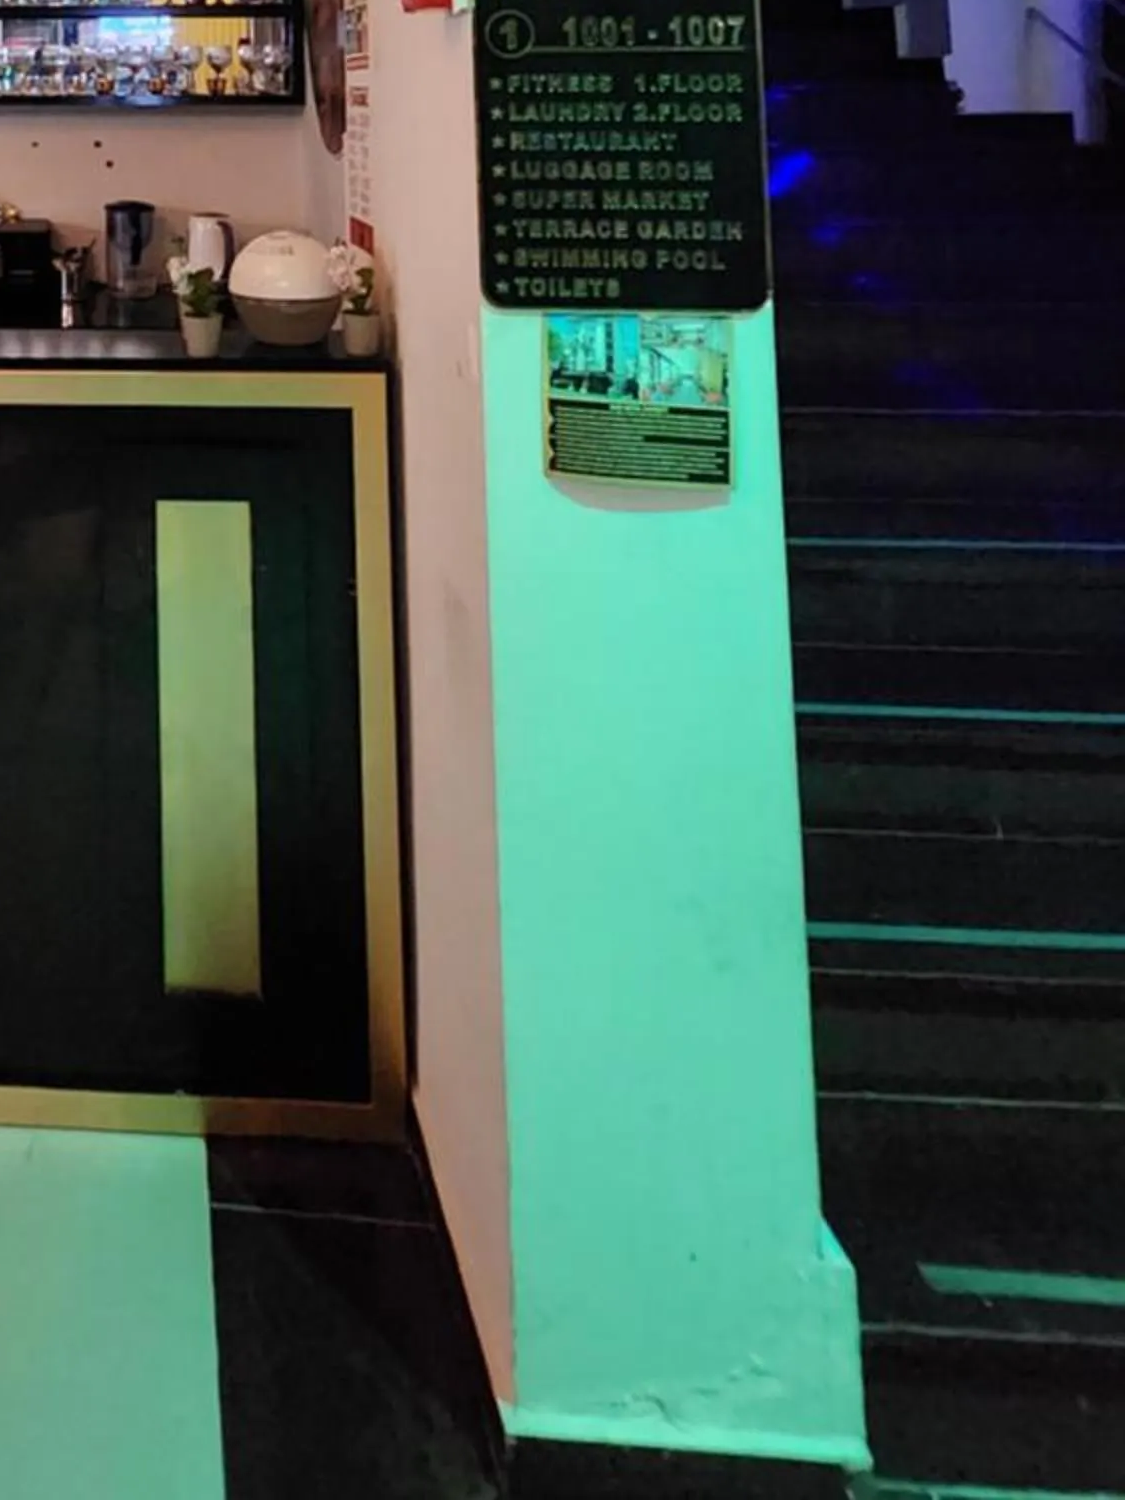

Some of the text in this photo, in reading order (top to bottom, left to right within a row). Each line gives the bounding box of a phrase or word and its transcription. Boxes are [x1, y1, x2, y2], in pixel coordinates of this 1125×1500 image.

[498, 20, 519, 50] 1
[562, 16, 636, 47] 1001
[669, 15, 746, 46] 1007
[507, 74, 614, 93] FITNESS
[508, 102, 625, 122] LAUNDRY
[510, 132, 678, 151] RESTAURANT
[510, 160, 714, 181] LUGGAGE ROOM
[512, 190, 711, 211] SUPER MARKET
[512, 219, 744, 241] TERRACE GARDEN
[513, 249, 726, 270] SWIMMING POOL
[514, 277, 621, 298] TOILETS
